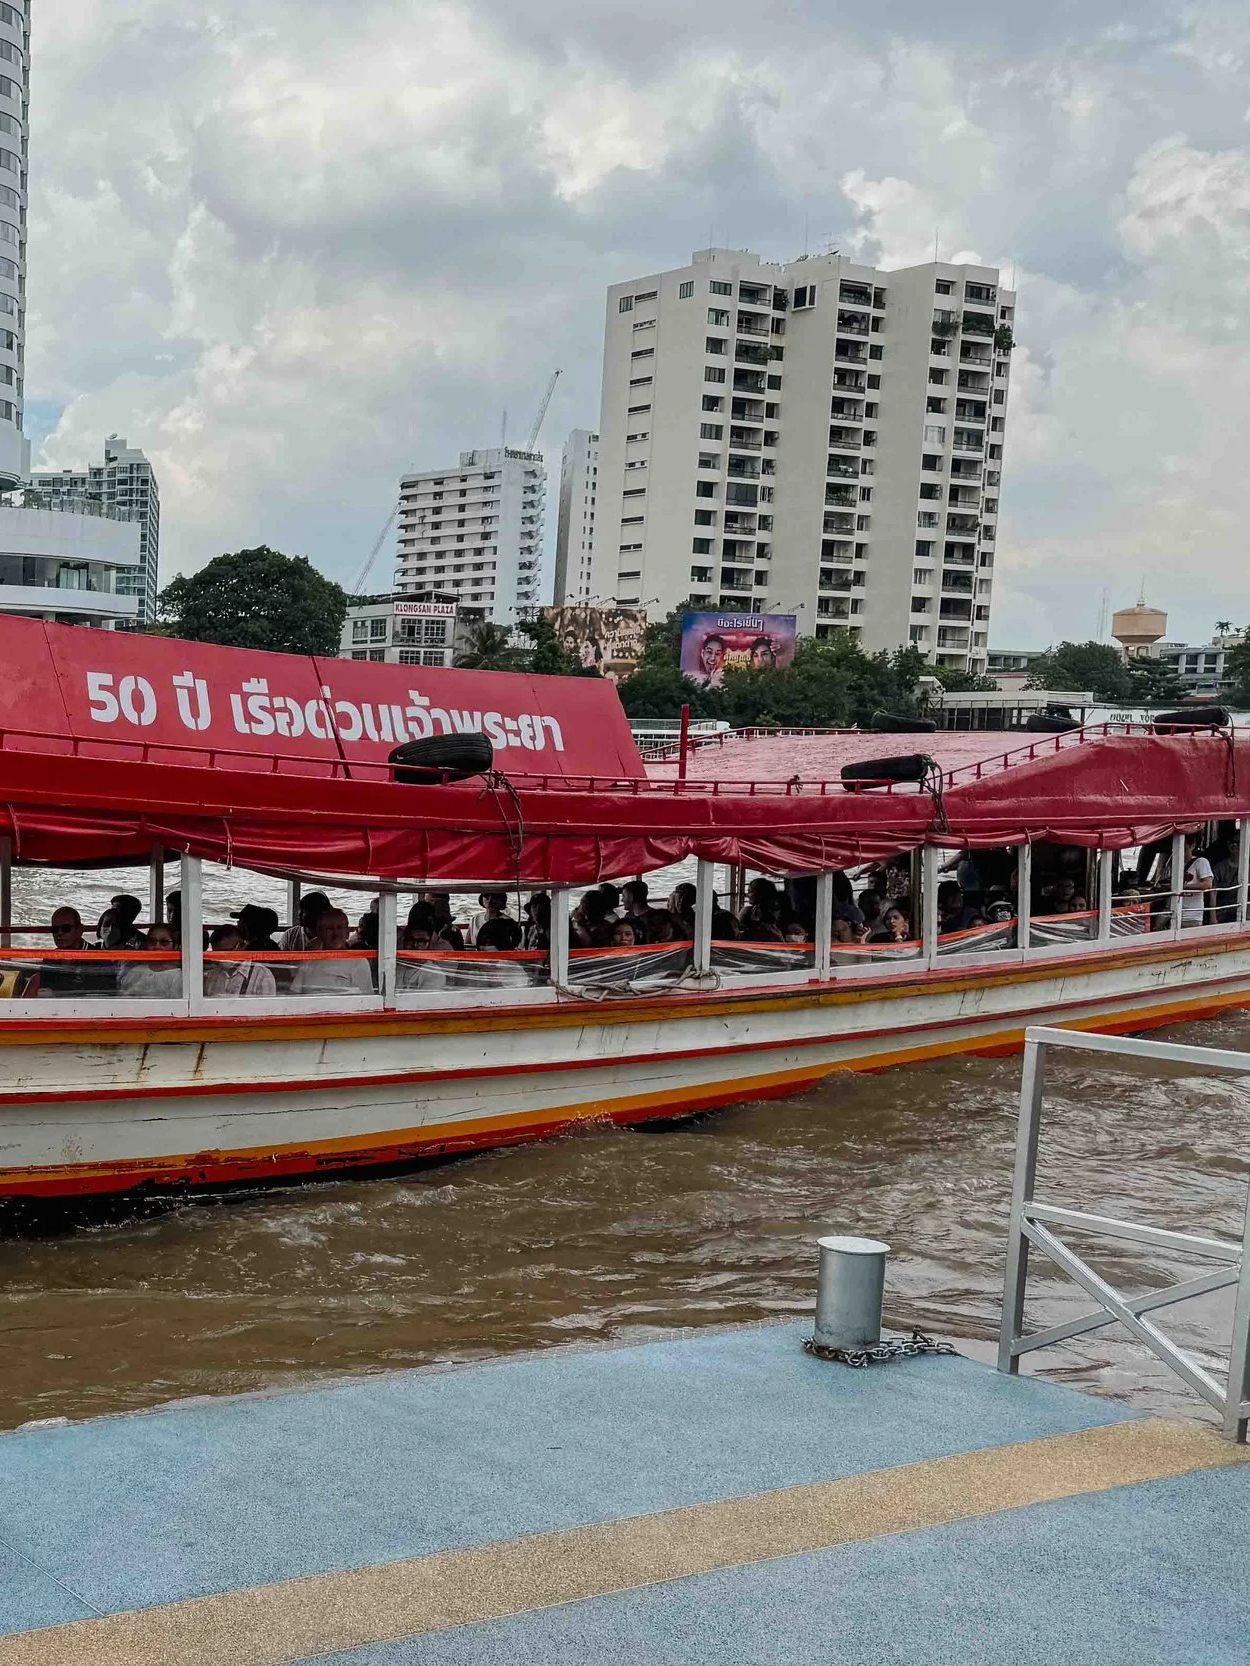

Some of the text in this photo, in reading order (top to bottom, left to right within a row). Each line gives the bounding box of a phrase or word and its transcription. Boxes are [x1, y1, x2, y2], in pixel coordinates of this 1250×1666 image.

[395, 604, 454, 614] KLONGSAN PLAZA
[86, 671, 565, 752] 50 ปี เรือด่วนเจ้าพระยา
